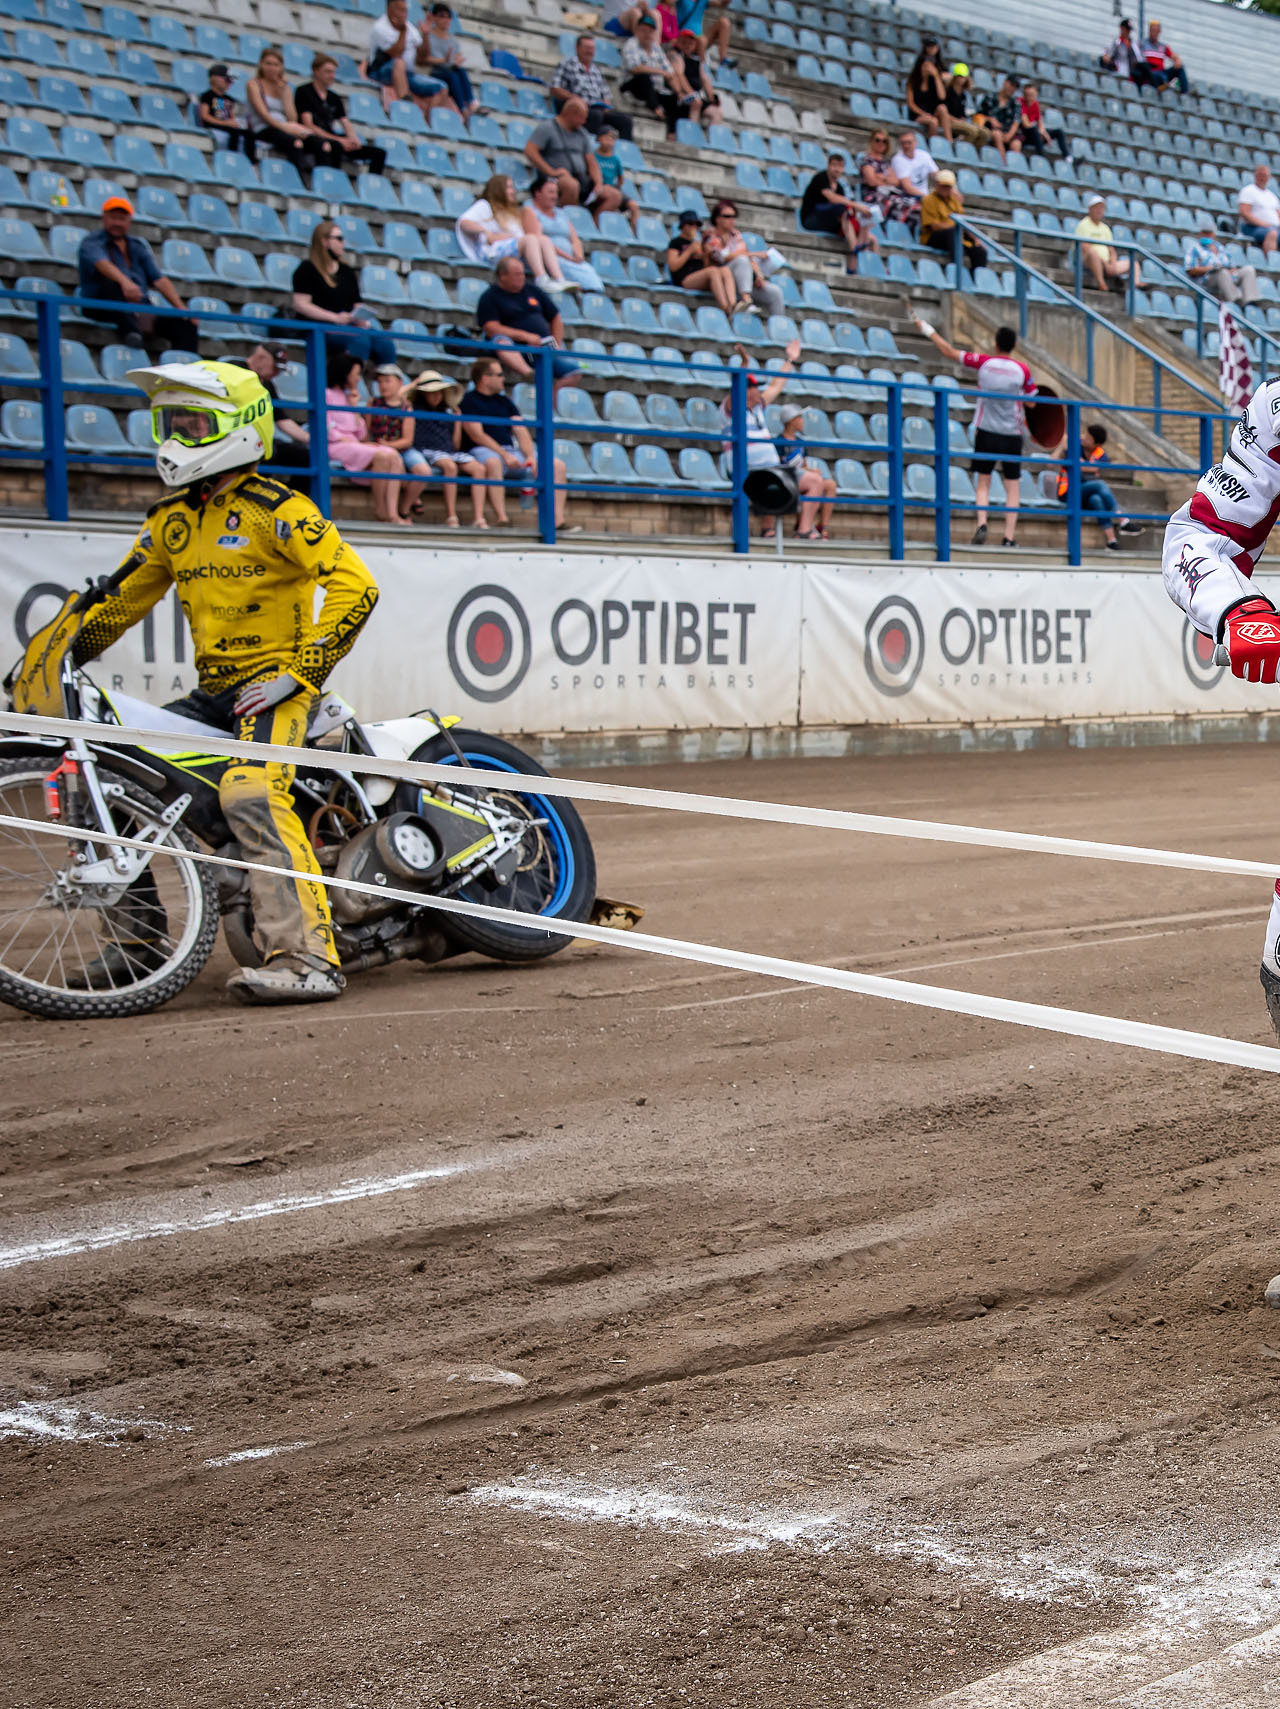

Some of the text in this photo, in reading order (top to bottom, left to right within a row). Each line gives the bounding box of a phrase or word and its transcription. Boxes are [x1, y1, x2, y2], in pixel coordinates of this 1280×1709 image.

[551, 598, 757, 666] OPTIBET
[939, 607, 1092, 666] OPTIBET
[551, 674, 667, 690] SPORTA
[938, 671, 1028, 687] SPORTA
